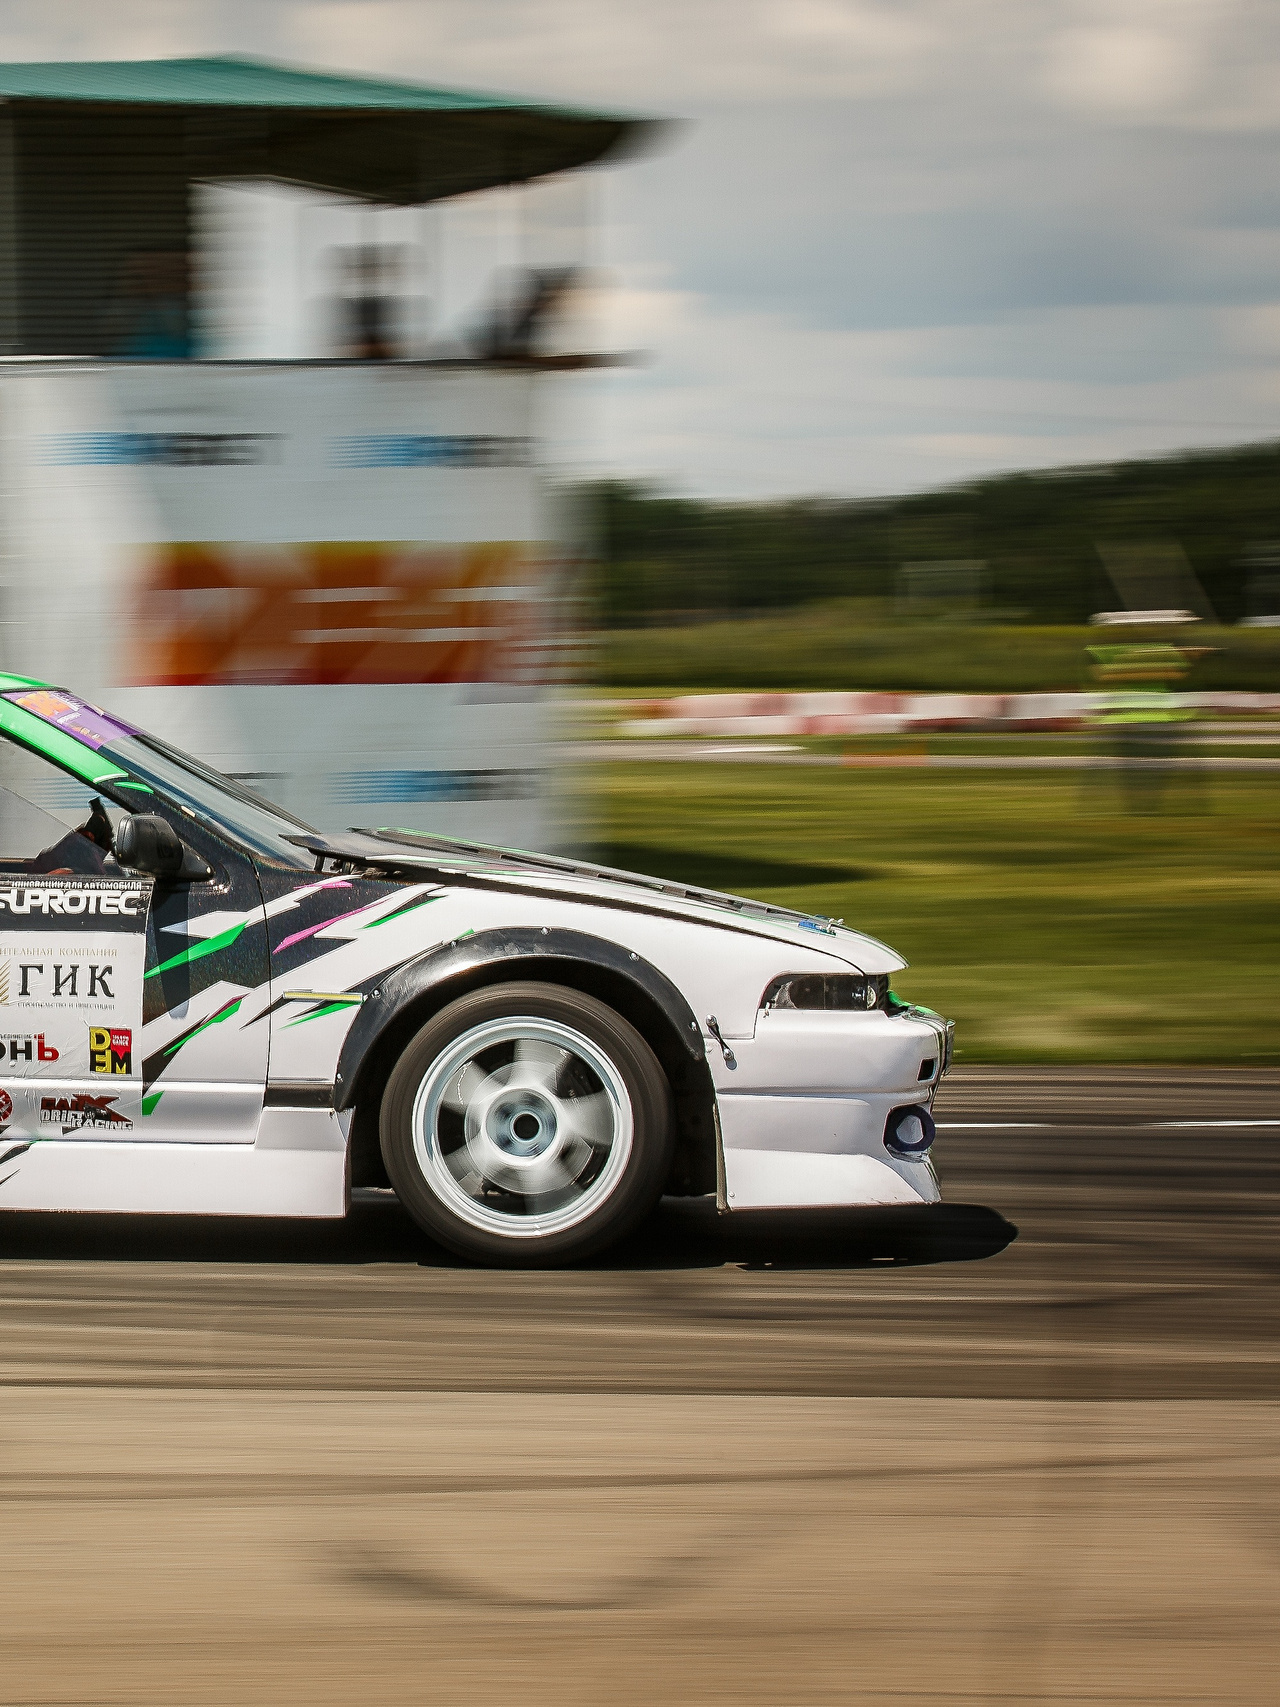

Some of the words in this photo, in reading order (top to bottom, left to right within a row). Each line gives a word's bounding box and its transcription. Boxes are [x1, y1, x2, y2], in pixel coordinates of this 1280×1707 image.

[83, 881, 142, 890] АВТОМОБИЛЯ
[59, 947, 118, 957] КОМПАНИЯ
[18, 963, 115, 998] ГИК
[41, 1109, 84, 1123] DRIFT
[71, 1118, 133, 1131] RACING
